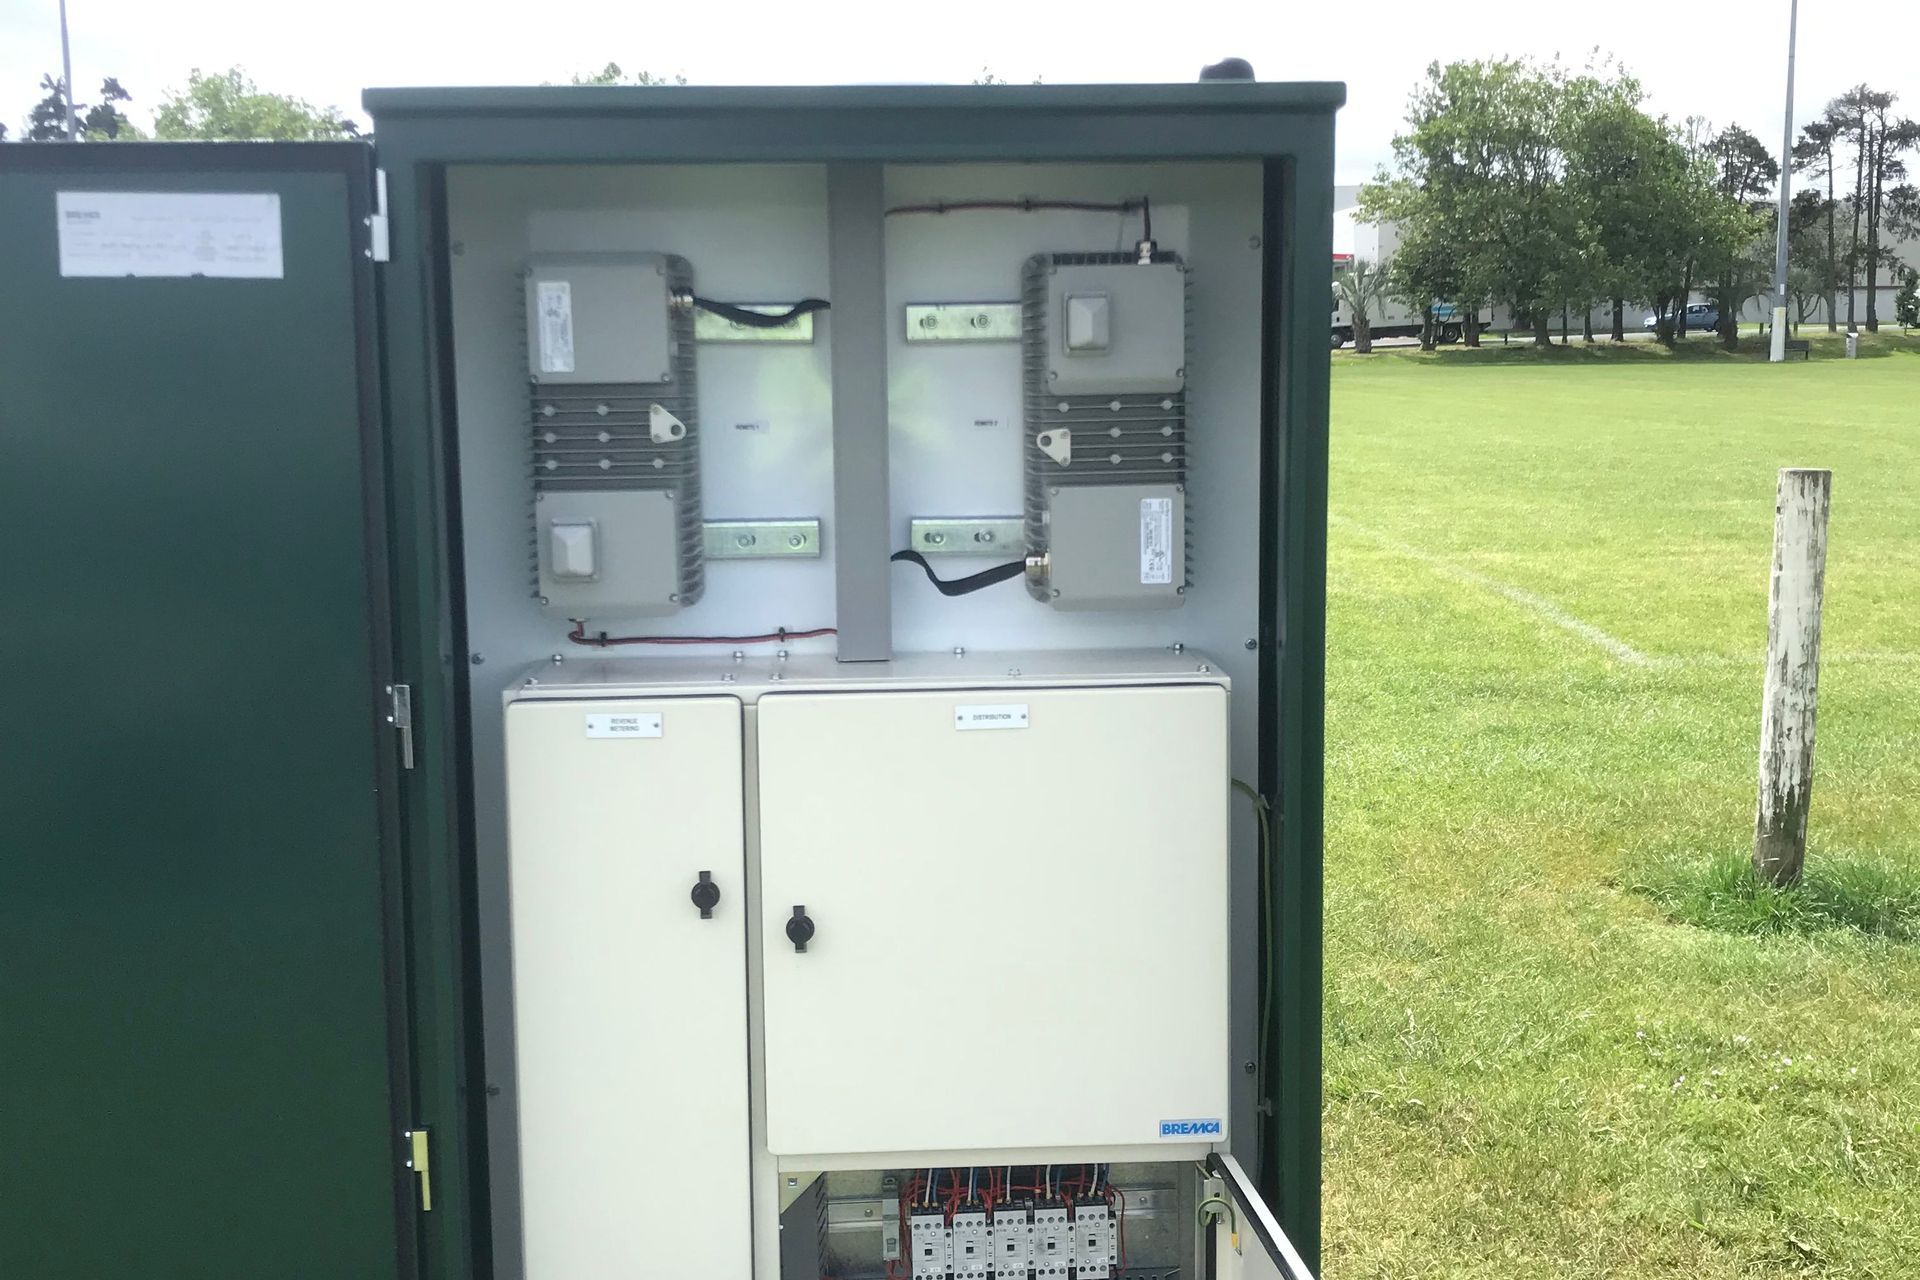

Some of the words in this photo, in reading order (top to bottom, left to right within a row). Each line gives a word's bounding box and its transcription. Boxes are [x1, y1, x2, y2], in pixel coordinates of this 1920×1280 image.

[610, 717, 638, 725] REVENUE
[972, 713, 1012, 721] DISTRIBUTION
[1161, 1121, 1220, 1135] BREMCA
